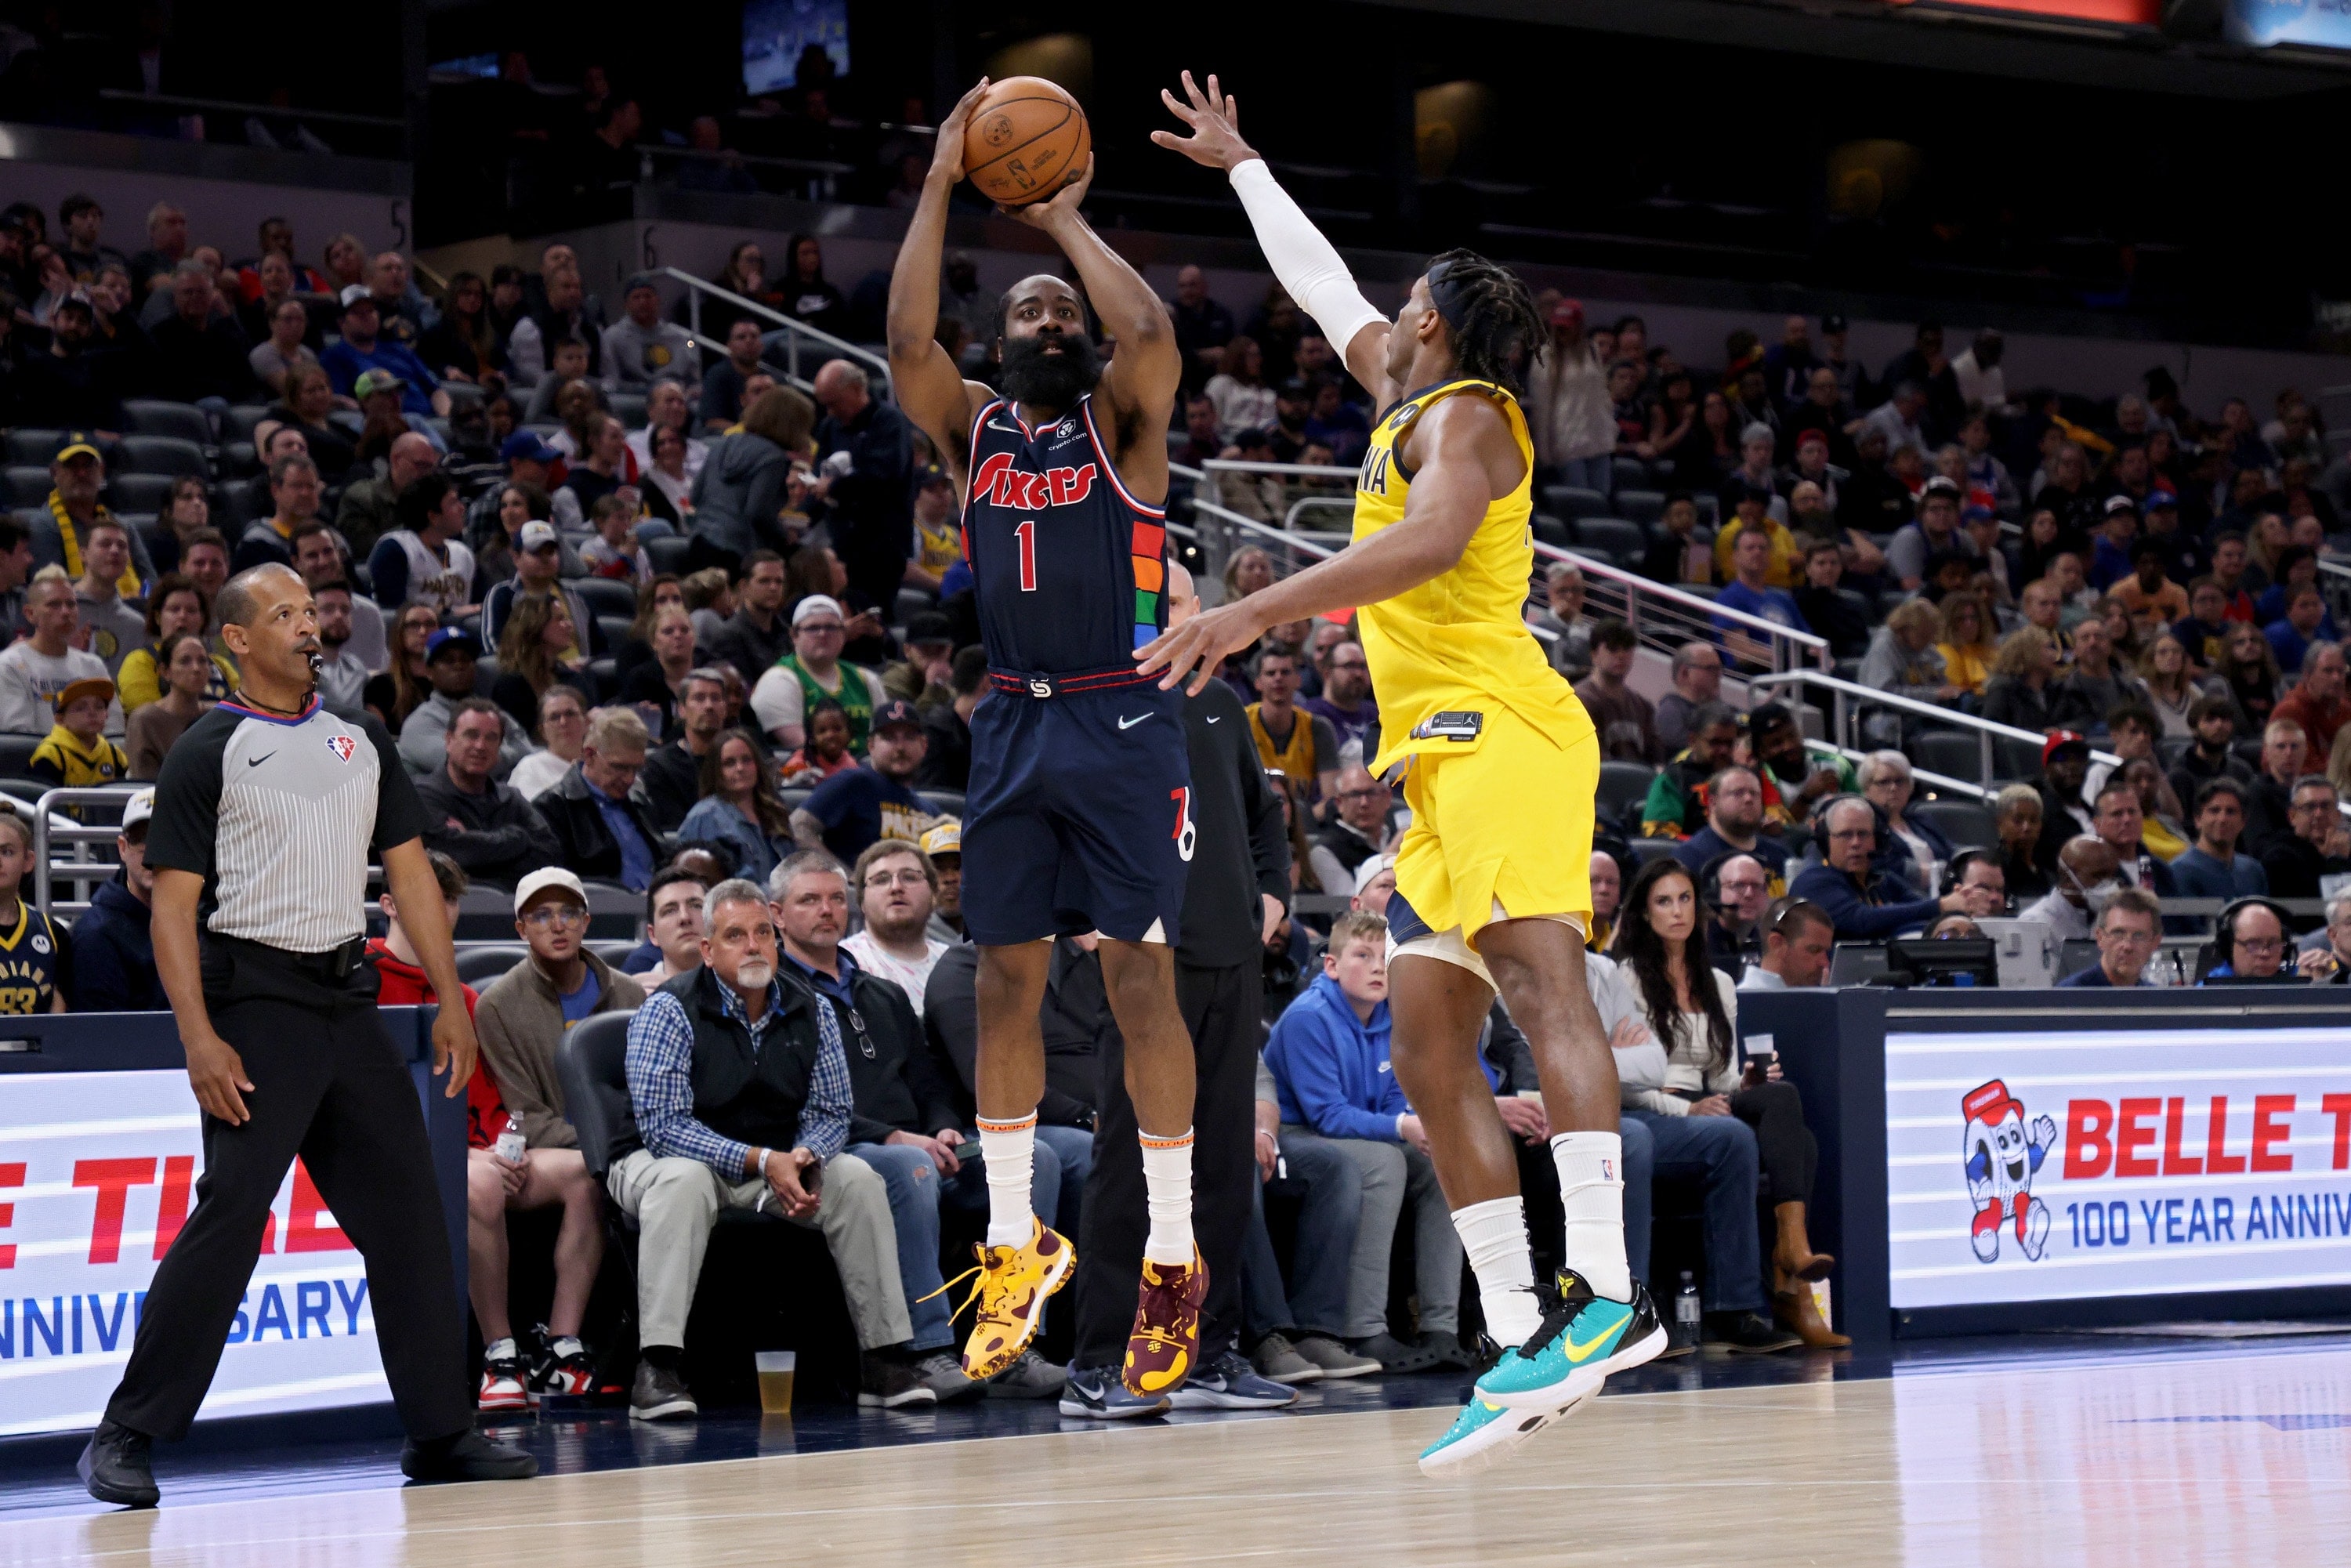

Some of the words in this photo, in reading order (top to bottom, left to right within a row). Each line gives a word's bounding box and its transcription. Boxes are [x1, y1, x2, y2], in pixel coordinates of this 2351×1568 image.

[1049, 432, 1088, 451] crypto.com
[1014, 520, 1037, 592] 1
[2063, 1095, 2297, 1180] BELLE
[72, 1153, 356, 1264] TIE
[2067, 1200, 2130, 1248] 100
[2140, 1197, 2235, 1244] YEAR
